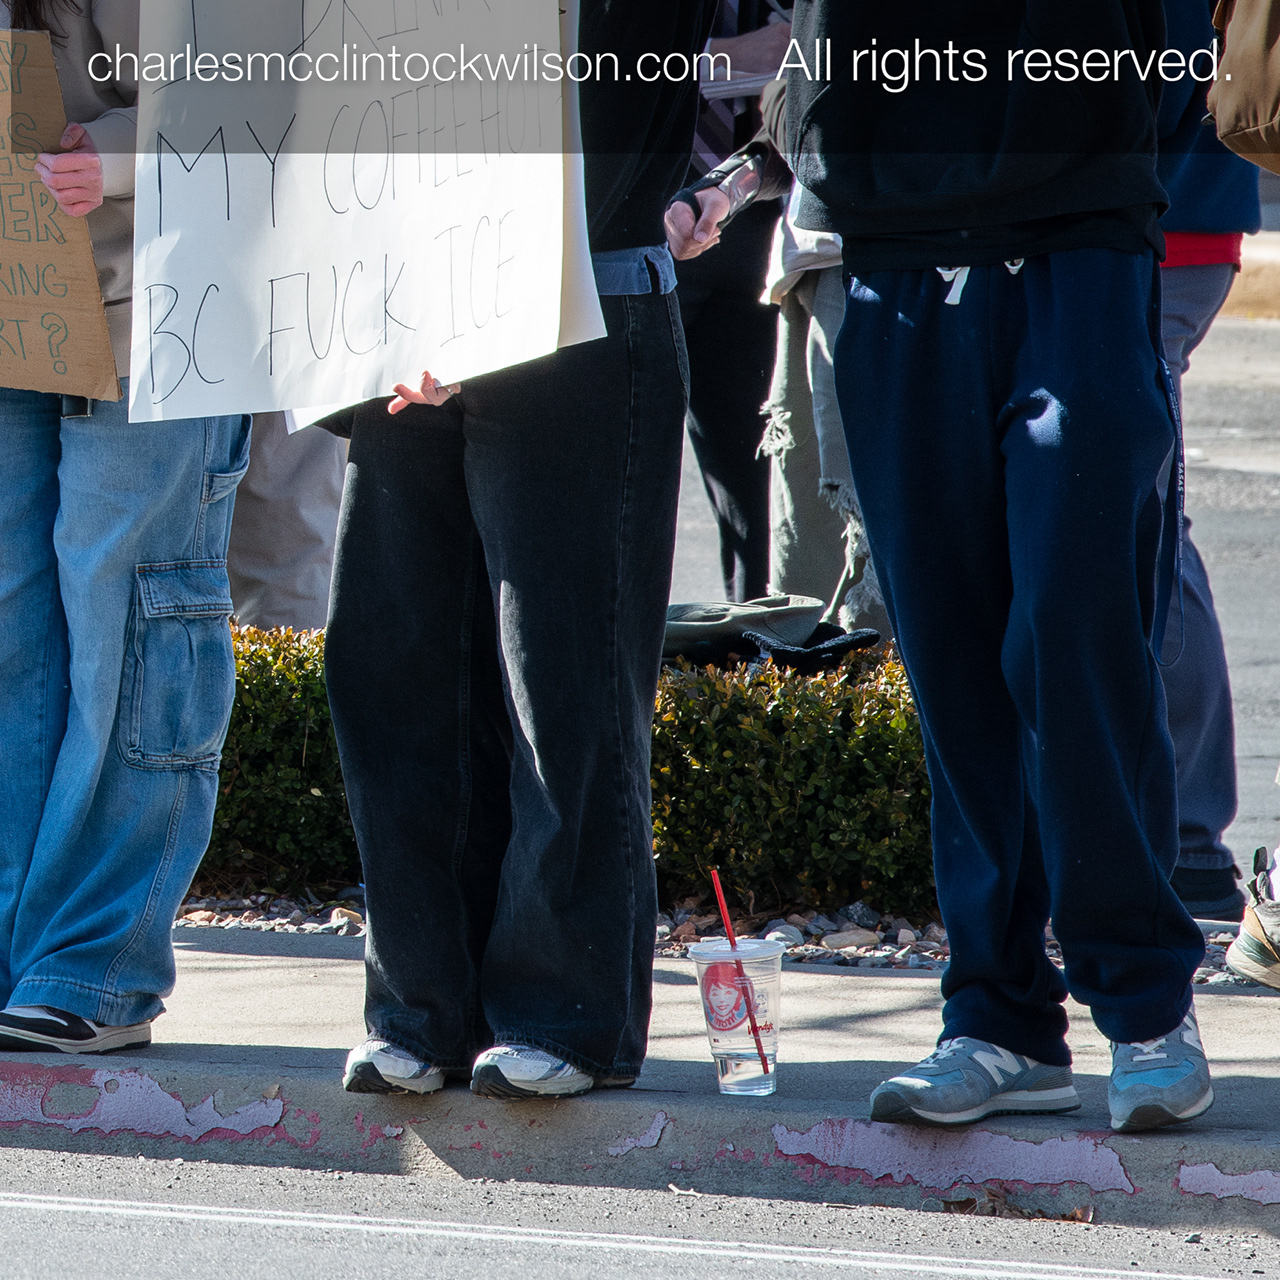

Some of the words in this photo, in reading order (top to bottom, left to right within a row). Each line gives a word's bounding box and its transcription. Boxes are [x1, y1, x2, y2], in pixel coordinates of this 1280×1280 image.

[156, 113, 298, 237] MY
[323, 72, 474, 214] COFFEE
[144, 282, 226, 405] BC
[267, 253, 417, 376] FUCK
[433, 209, 516, 348] ICE
